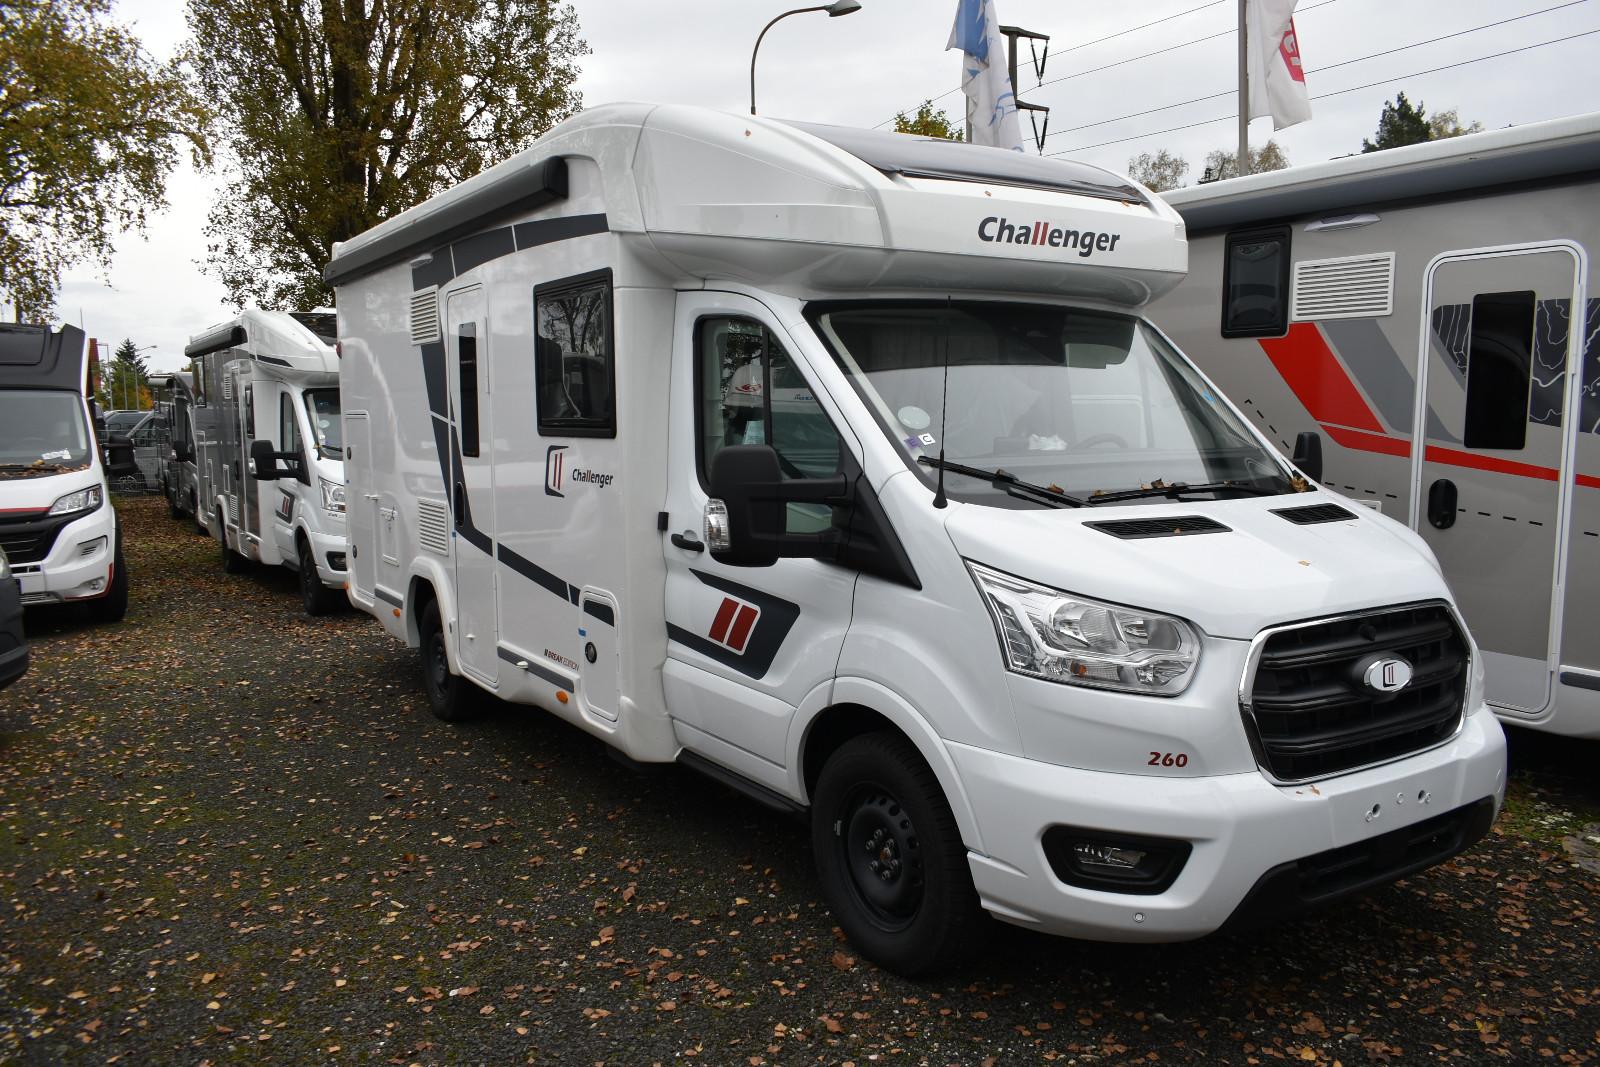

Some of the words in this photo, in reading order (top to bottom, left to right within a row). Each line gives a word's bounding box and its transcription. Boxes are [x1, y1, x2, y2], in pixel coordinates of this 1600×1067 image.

[977, 216, 1121, 258] Challenger
[572, 468, 614, 489] Challenger
[1147, 751, 1188, 768] 260
